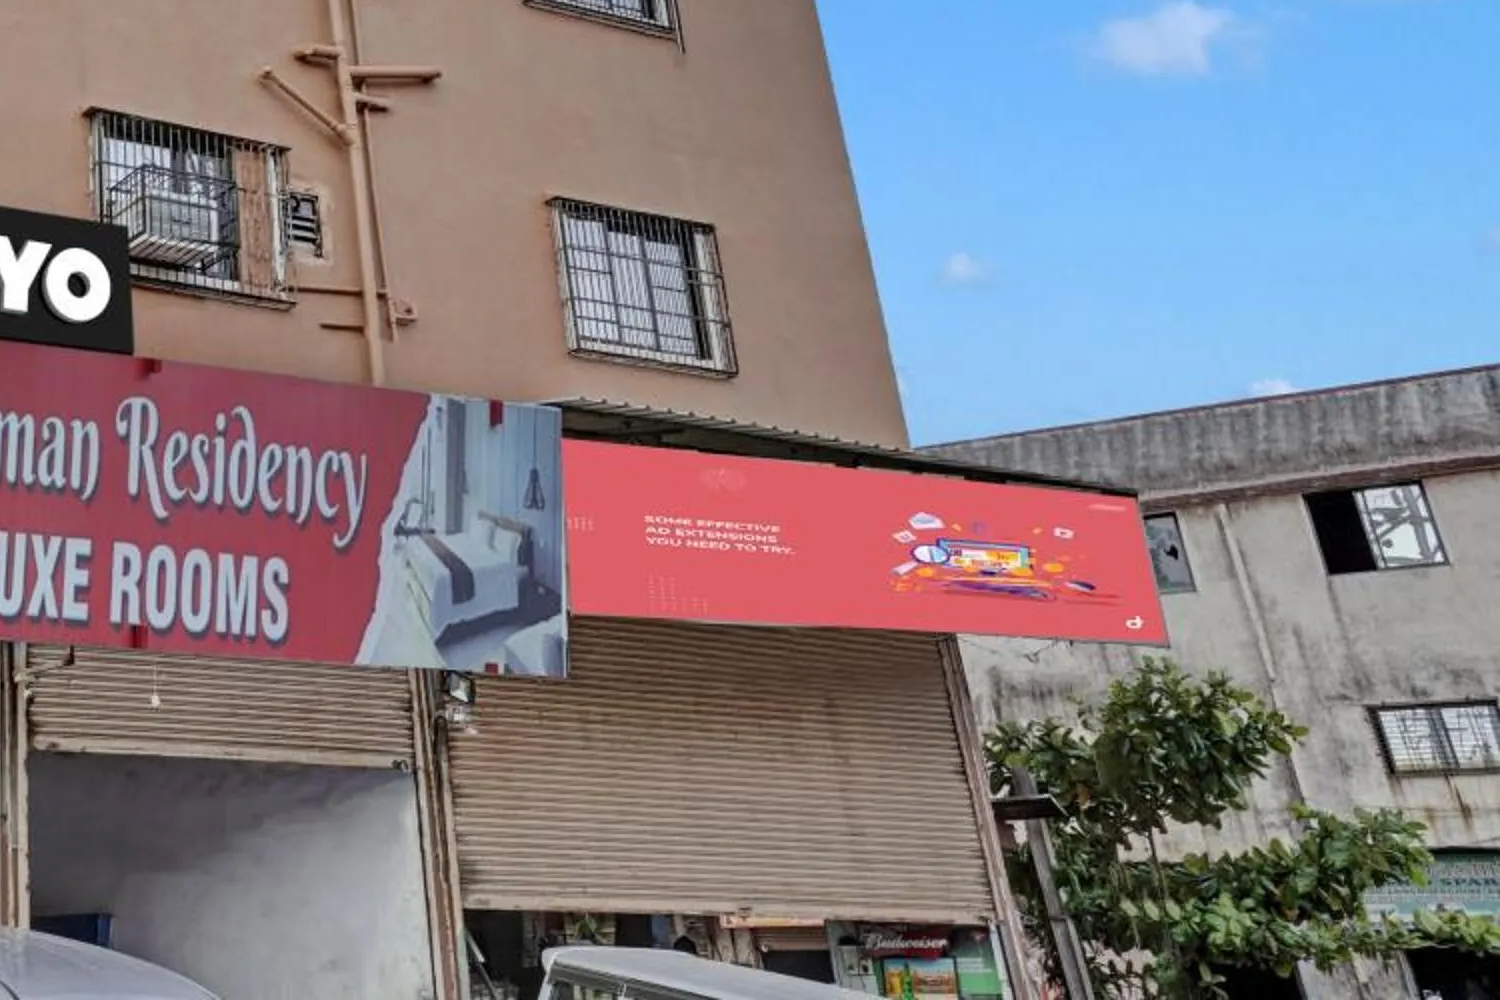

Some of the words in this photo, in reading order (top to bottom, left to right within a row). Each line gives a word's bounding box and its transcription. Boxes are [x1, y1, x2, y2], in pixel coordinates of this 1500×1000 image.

[115, 396, 367, 549] Residency
[697, 519, 781, 533] EFFECTIVE
[676, 528, 778, 543] EXTENSIONS
[646, 537, 682, 547] YOU
[686, 540, 731, 551] NEED
[734, 544, 757, 553] TO
[110, 541, 289, 641] ROOMS
